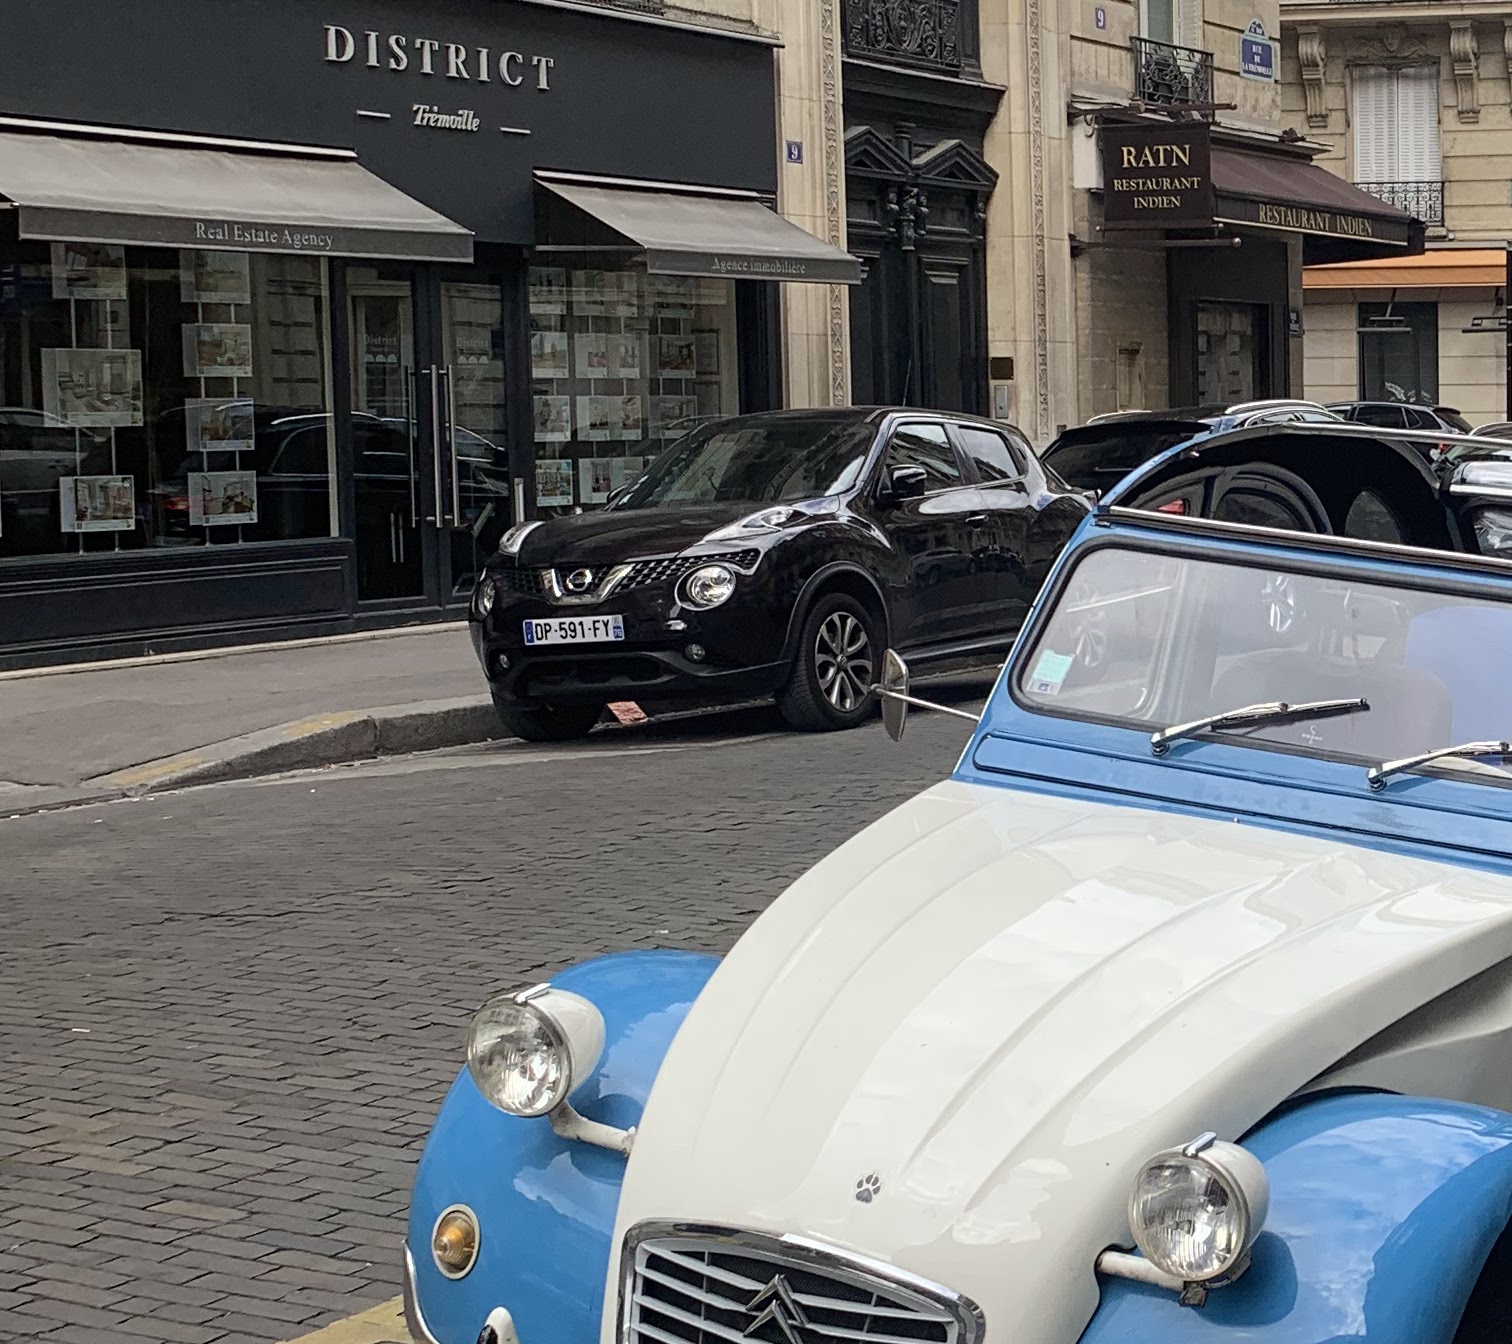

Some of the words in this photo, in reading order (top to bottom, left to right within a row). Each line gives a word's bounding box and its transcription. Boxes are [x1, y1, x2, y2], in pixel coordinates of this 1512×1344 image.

[324, 24, 554, 90] DISTRICT
[1121, 144, 1191, 168] RATN
[1113, 177, 1201, 191] RESTAURANT
[1133, 196, 1181, 209] INDIEN
[1259, 203, 1331, 232] RESTAURANT
[1336, 214, 1373, 237] INDIEN
[195, 221, 229, 240] Real
[233, 224, 278, 243] Estate
[281, 229, 333, 250] Agency
[712, 256, 748, 273] Agence
[534, 619, 610, 641] DP-591-FY
